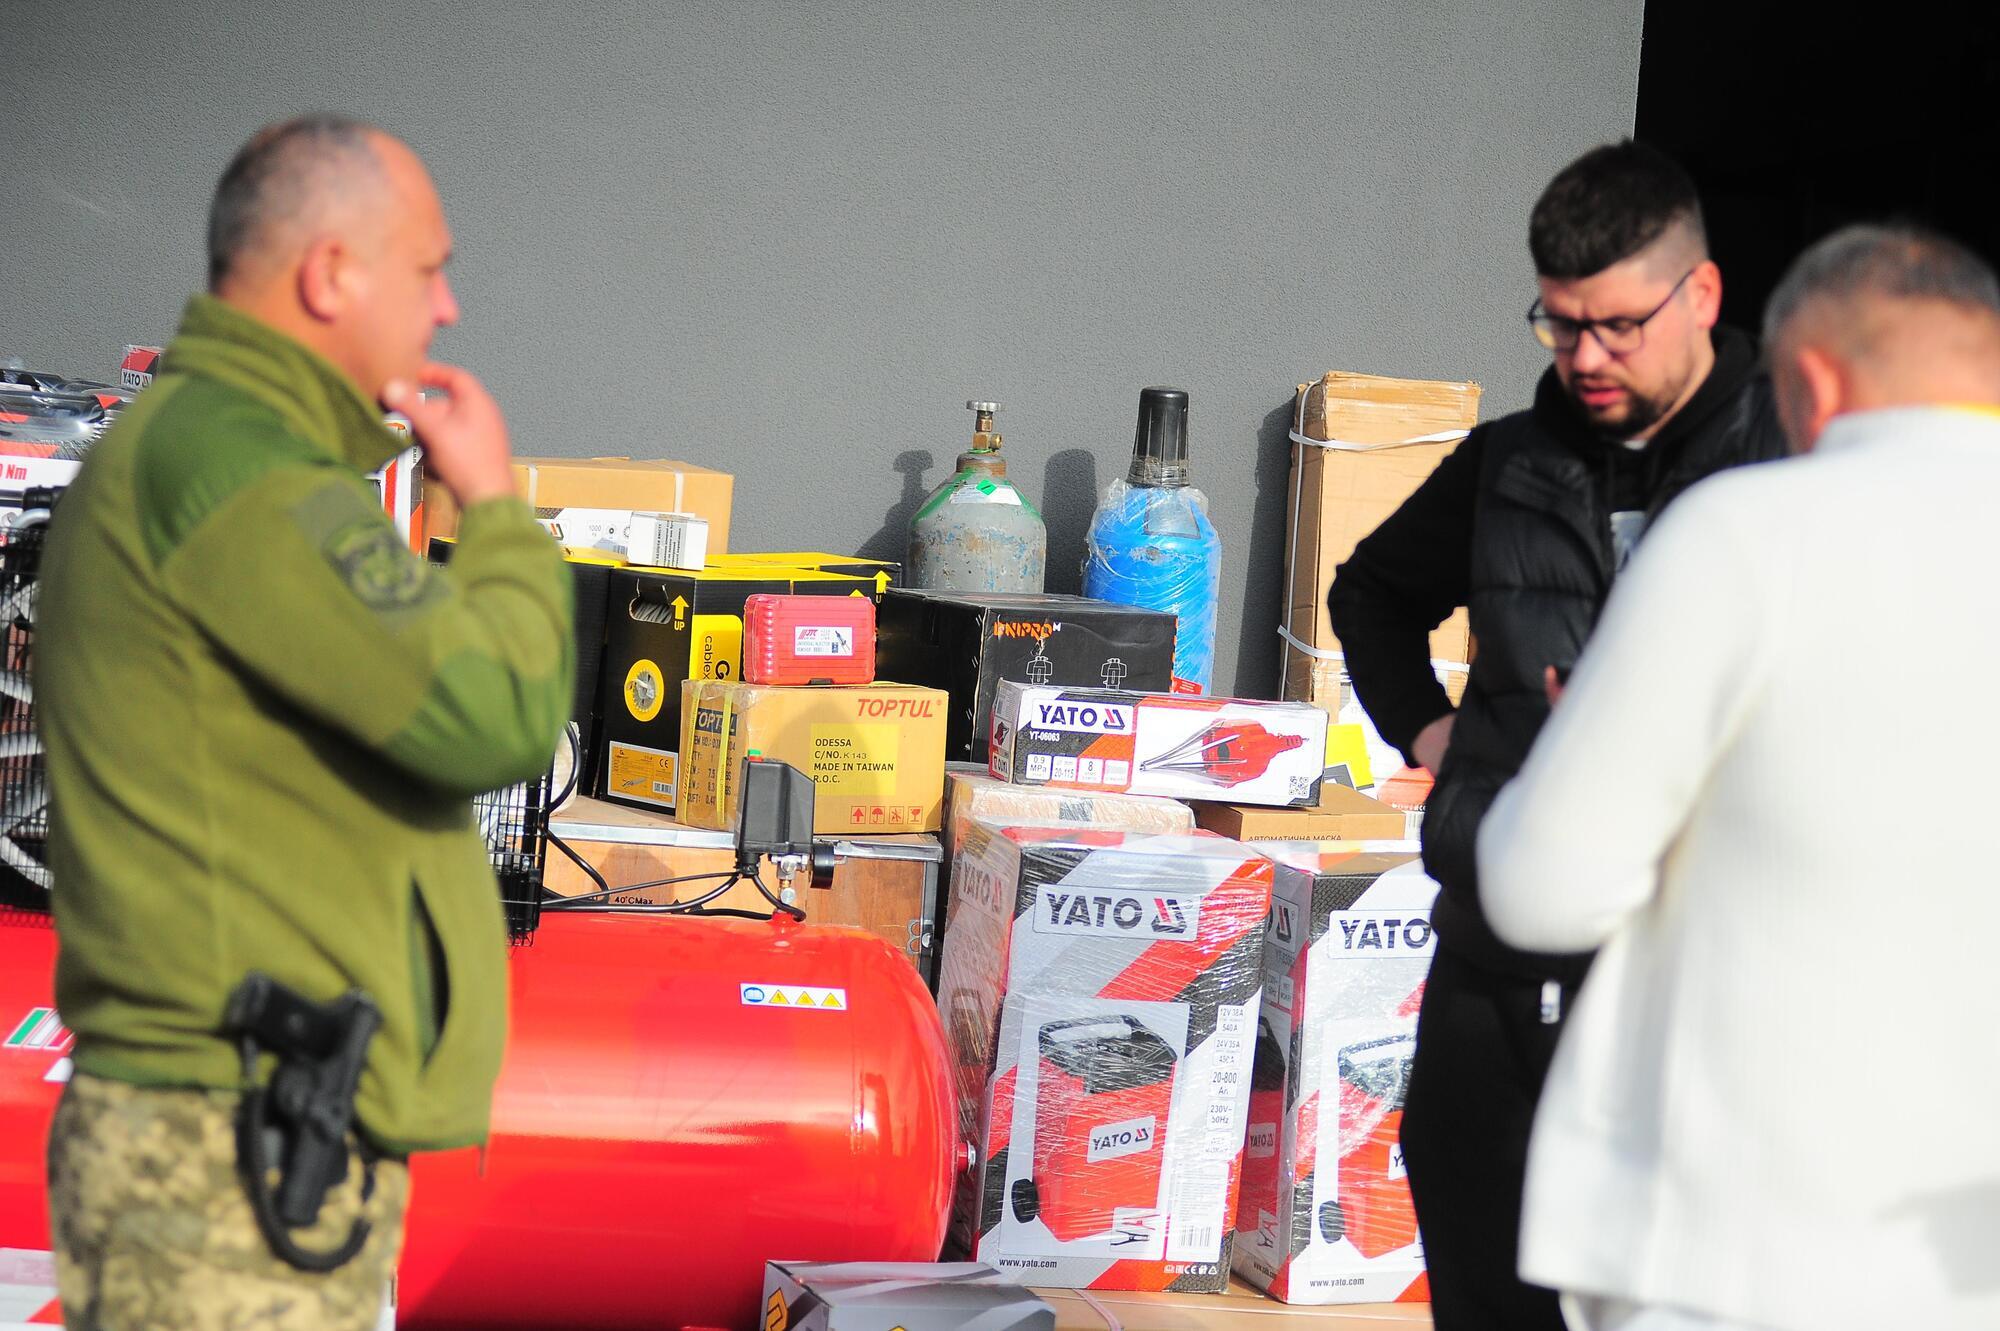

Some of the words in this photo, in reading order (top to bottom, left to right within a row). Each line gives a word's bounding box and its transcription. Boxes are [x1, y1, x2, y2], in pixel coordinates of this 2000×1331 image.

[122, 371, 141, 386] YATO
[5, 464, 27, 480] Nm
[673, 620, 685, 631] UP
[703, 635, 713, 680] cablex
[858, 698, 933, 718] TOPTUL
[697, 711, 735, 732] OPTL
[1039, 704, 1098, 727] YATO
[815, 738, 852, 747] ODESSA
[814, 750, 842, 760] C/NO.
[813, 763, 840, 771] MADE
[842, 763, 853, 771] IN
[856, 763, 894, 771] TAIWAN
[1030, 764, 1047, 773] MPa
[813, 775, 841, 783] R.O.C.
[1046, 893, 1143, 930] YATO
[1338, 918, 1432, 949] YATO
[1093, 1132, 1132, 1151] YATO
[1250, 1134, 1267, 1148] YATO
[999, 1258, 1058, 1268] www.yato.com
[1309, 1278, 1365, 1288] www.yato.com
